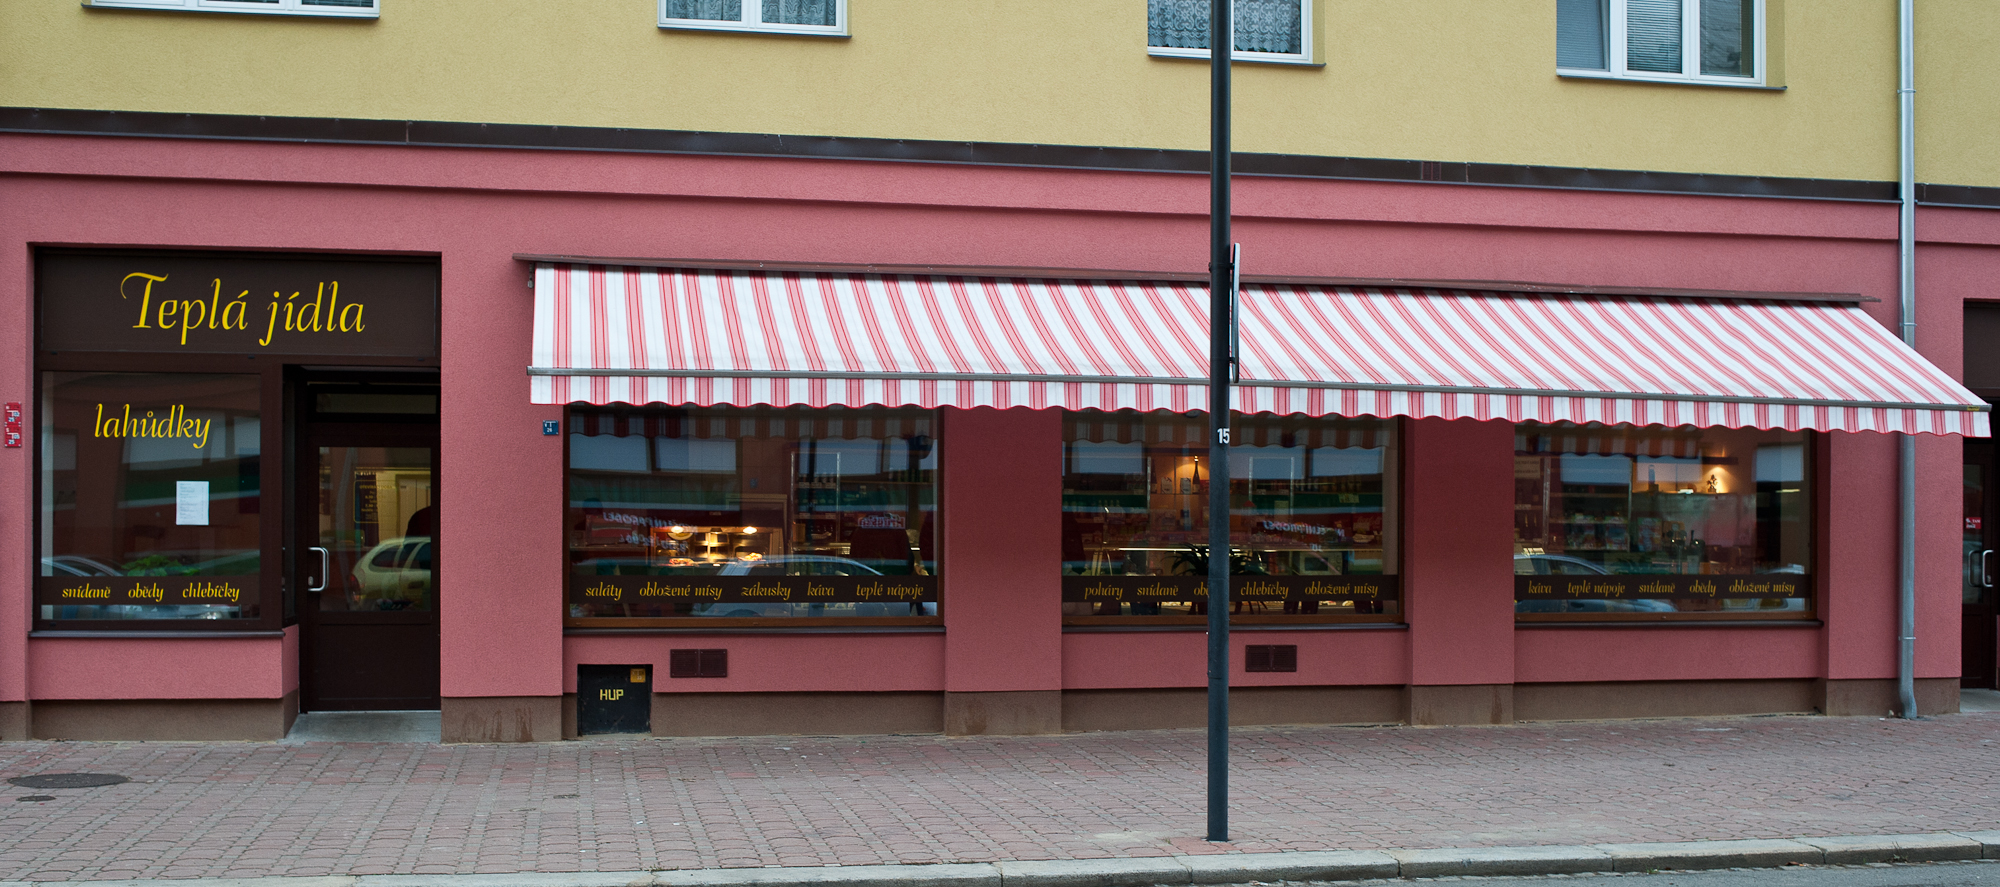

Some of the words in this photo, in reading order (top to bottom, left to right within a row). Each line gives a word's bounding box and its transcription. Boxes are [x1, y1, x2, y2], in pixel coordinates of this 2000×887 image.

[120, 272, 249, 346] Teplá
[259, 281, 366, 347] jídla
[95, 404, 211, 449] lahůdky
[1217, 428, 1230, 444] 15
[62, 583, 111, 599] snídaně
[128, 582, 164, 602] obědy
[182, 582, 240, 602] chlebíčky
[585, 582, 622, 601] saláty
[639, 581, 691, 597] obložené
[694, 584, 723, 601] mísy
[741, 582, 791, 601] zákusky
[807, 581, 835, 597] káva
[856, 581, 883, 600] teplé
[887, 584, 924, 600] nápoje
[1084, 581, 1124, 601] poháry
[1136, 582, 1179, 596] snídaně
[1240, 581, 1289, 599] chlebíčky
[1304, 581, 1350, 595] obložené
[1353, 583, 1379, 598] mísy
[1528, 580, 1552, 594] káva
[1567, 579, 1591, 597] teplé
[1594, 582, 1626, 597] nápoje
[1638, 580, 1676, 593] snídaně
[1689, 579, 1717, 597] obědy
[1729, 579, 1770, 593] obložené
[1773, 581, 1795, 597] mísy
[599, 688, 624, 701] HUP
